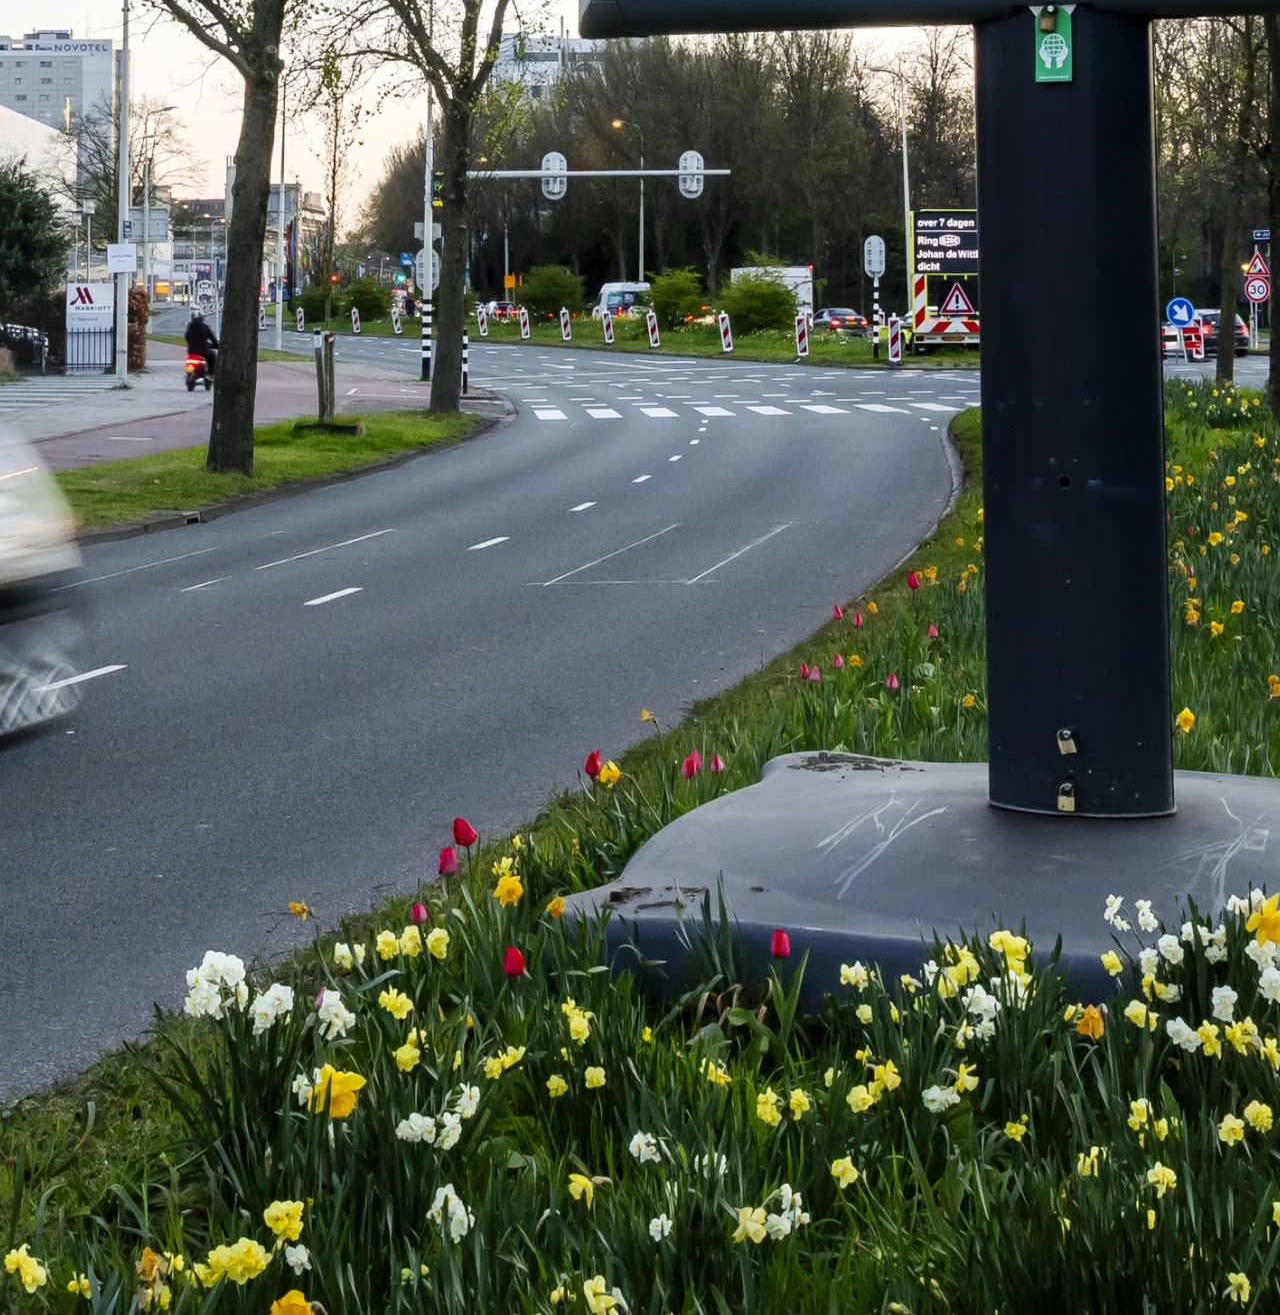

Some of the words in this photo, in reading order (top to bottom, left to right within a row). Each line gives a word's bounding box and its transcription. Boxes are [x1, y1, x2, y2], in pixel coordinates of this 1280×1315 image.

[54, 44, 108, 52] NOVOTEL
[939, 218, 945, 227] 7
[946, 218, 975, 229] dagen
[917, 236, 939, 247] Ring
[916, 249, 945, 259] Johan
[946, 249, 958, 259] de
[958, 249, 979, 259] Wittl
[917, 262, 940, 271] dicht
[1249, 285, 1265, 295] 30
